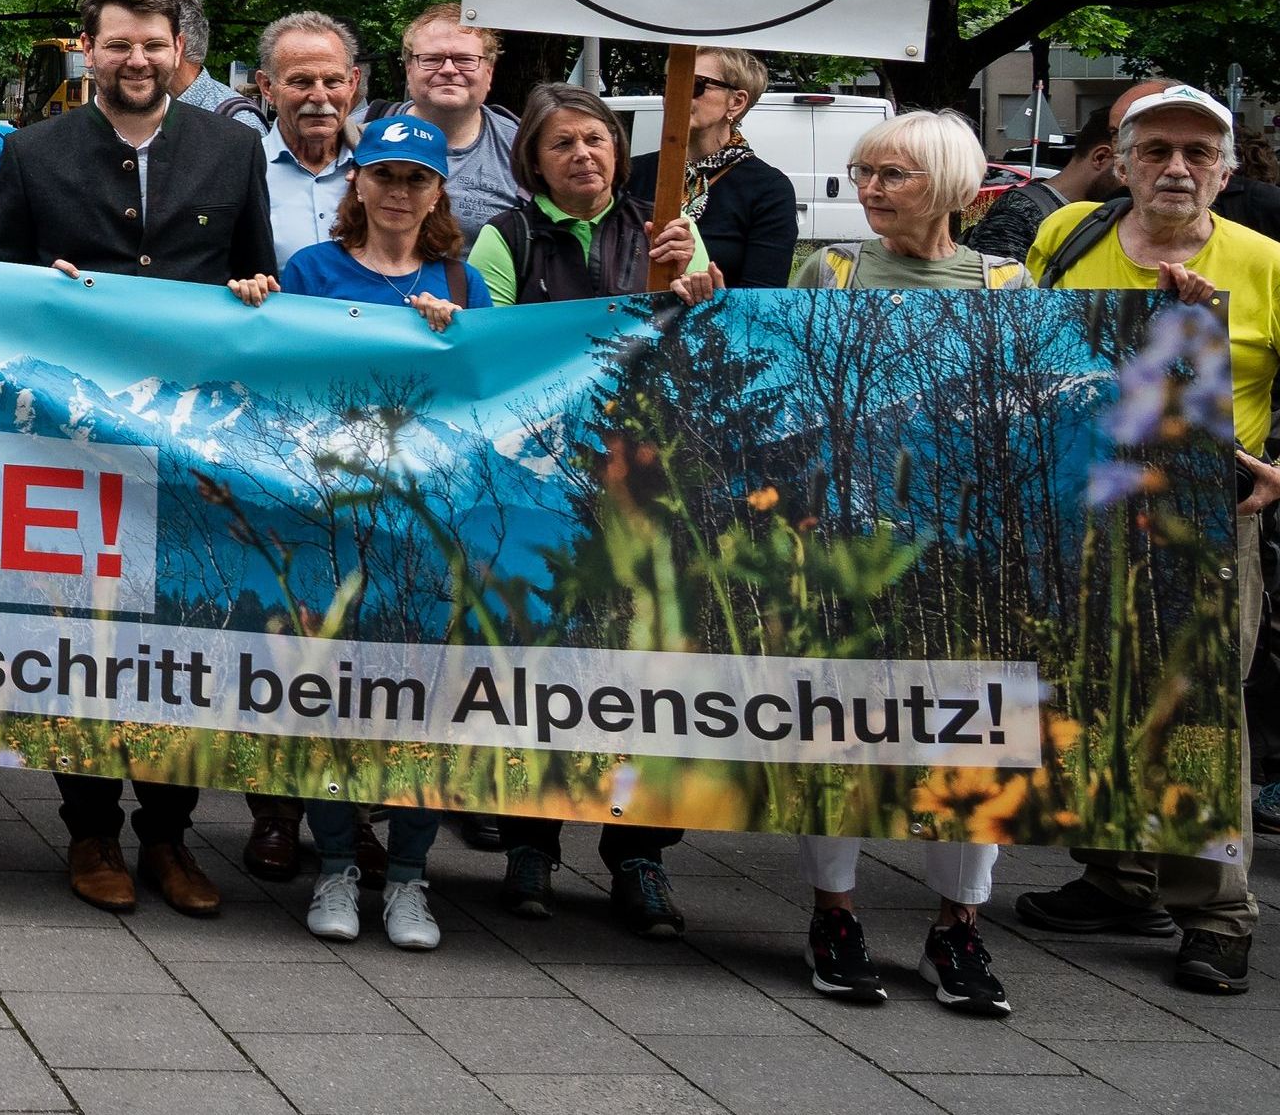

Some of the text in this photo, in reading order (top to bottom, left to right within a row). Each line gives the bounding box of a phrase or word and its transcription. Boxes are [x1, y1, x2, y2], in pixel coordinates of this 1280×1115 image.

[413, 127, 434, 141] LBV
[238, 653, 426, 721] beim
[451, 666, 1007, 745] Alpenschutz!
